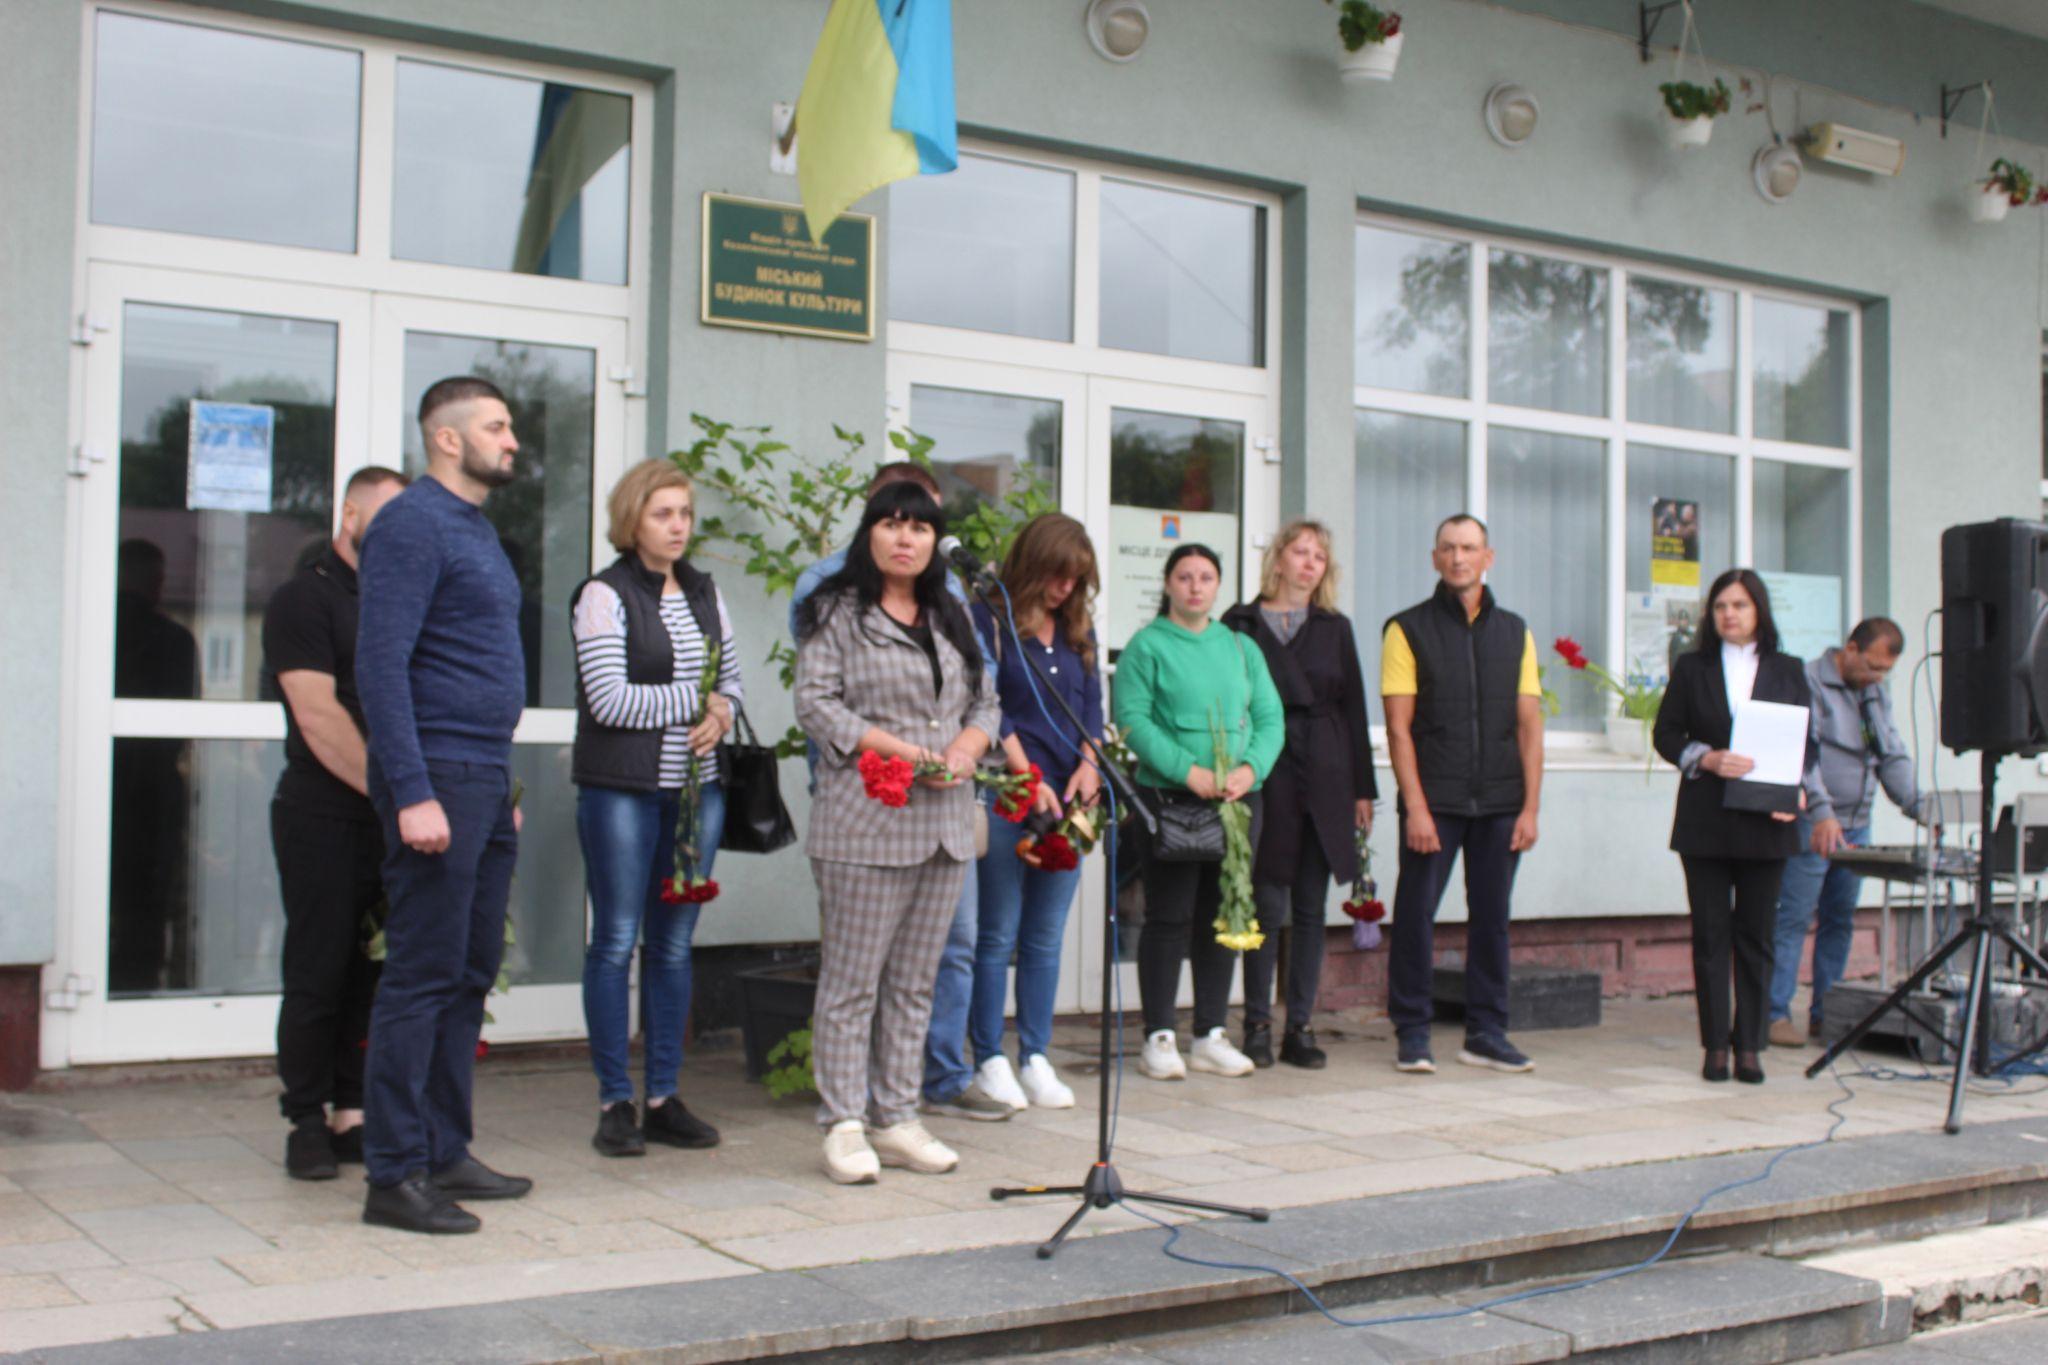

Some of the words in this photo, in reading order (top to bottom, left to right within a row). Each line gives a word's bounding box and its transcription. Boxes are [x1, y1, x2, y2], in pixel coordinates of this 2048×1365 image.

[756, 265, 823, 289] МІСЬКИЙ
[715, 282, 785, 306] БУДИНОК
[789, 291, 863, 316] КУЛЬТУРИ
